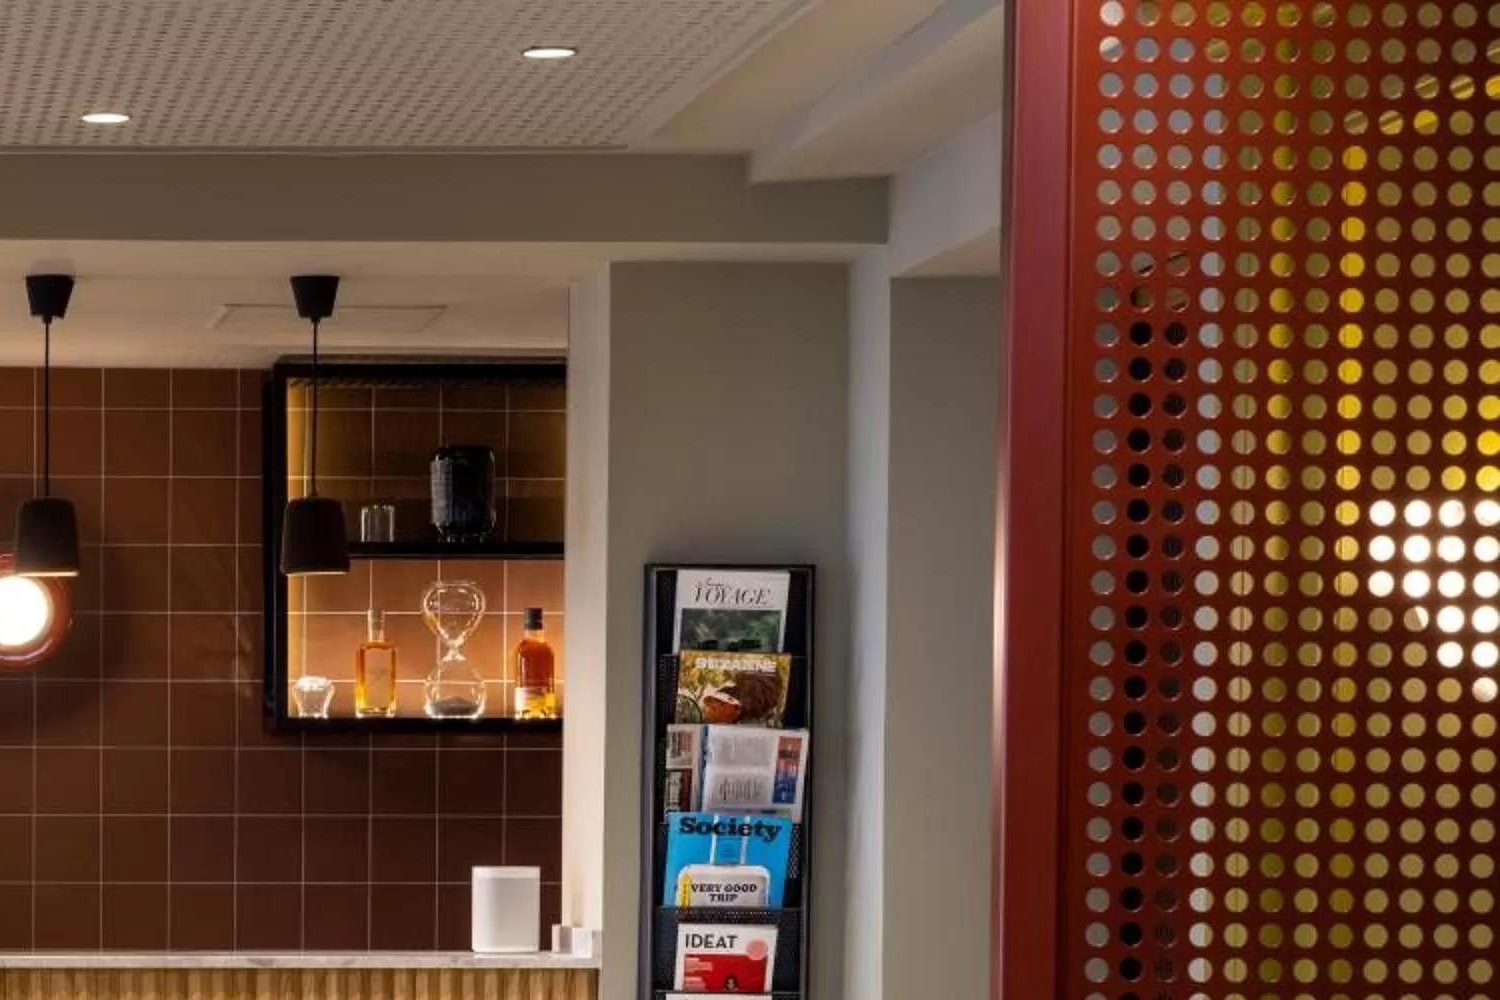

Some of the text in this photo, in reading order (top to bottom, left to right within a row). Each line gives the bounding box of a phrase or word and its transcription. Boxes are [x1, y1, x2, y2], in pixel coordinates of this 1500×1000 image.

[694, 582, 771, 605] VOYAGE
[679, 816, 782, 843] Society
[691, 883, 757, 893] VERY GOOD
[709, 893, 739, 902] TRIP
[685, 933, 739, 949] IDEAT
